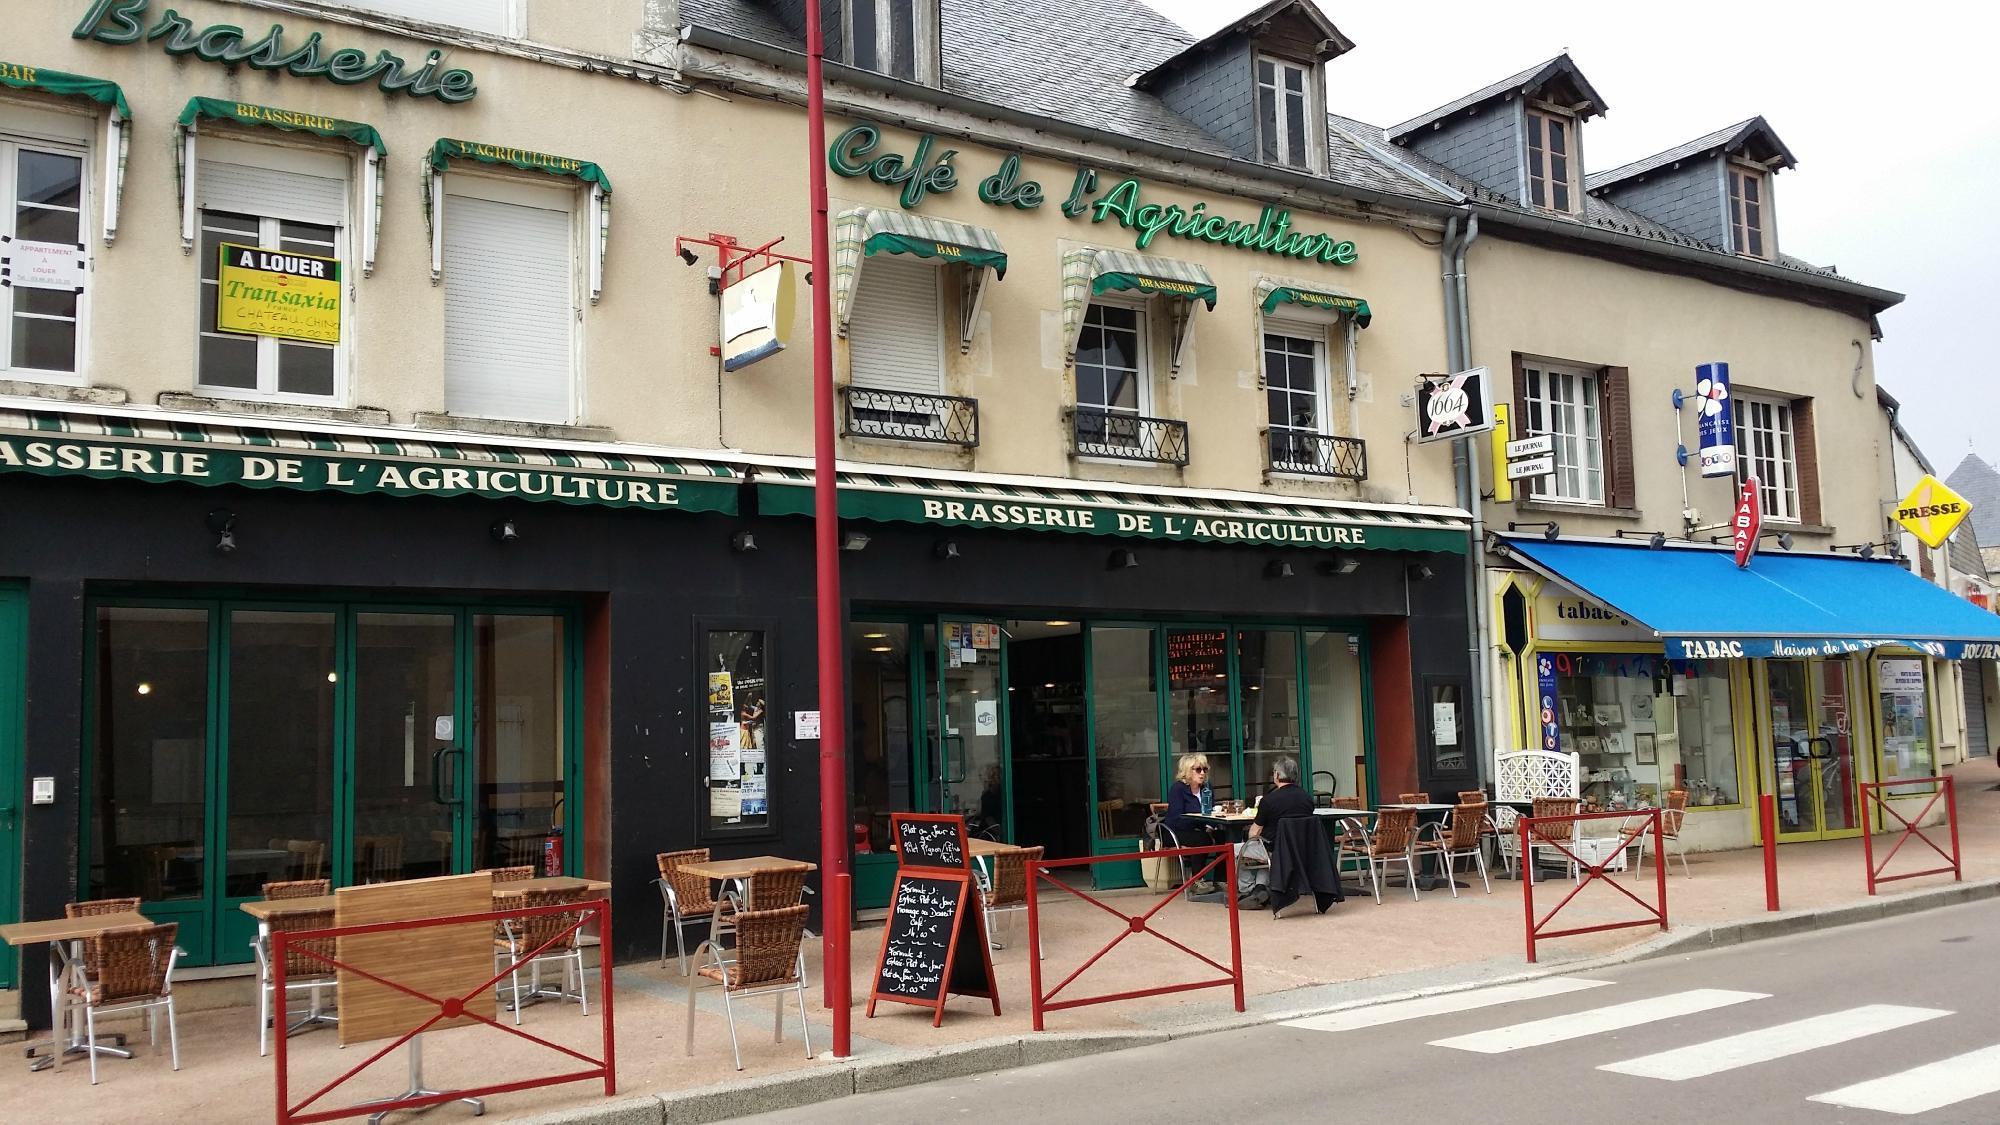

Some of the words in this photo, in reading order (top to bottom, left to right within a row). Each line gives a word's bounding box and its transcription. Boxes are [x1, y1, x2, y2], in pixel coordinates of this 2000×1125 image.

[72, 0, 478, 104] Brasserie
[236, 103, 334, 131] BRASSERIE
[460, 142, 580, 172] L'AGRICULTURE
[828, 123, 959, 209] Café
[978, 151, 1044, 209] de
[240, 250, 254, 268] A
[260, 253, 325, 277] LOUER
[936, 243, 962, 257] BAR
[226, 280, 337, 310] Transaxia
[1138, 277, 1198, 295] BRASSERIE
[1430, 392, 1465, 417] 1664
[1514, 445, 1522, 453] LE
[1521, 441, 1543, 452] JOURNAL
[241, 456, 304, 483] DE
[325, 461, 680, 505] L'AGRICULTURE
[1516, 466, 1523, 474] LE
[1523, 463, 1544, 474] JOURNAL
[922, 499, 1096, 529] BRASSERIE
[1117, 512, 1154, 534] DE
[1165, 515, 1366, 545] L'AGRICULTURE
[1736, 492, 1752, 552] TABAC
[1898, 502, 1962, 521] PRESSE
[1681, 640, 1745, 659] TABAC
[1772, 639, 1819, 658] Maison
[1822, 640, 1840, 655] de
[1844, 640, 1859, 653] la
